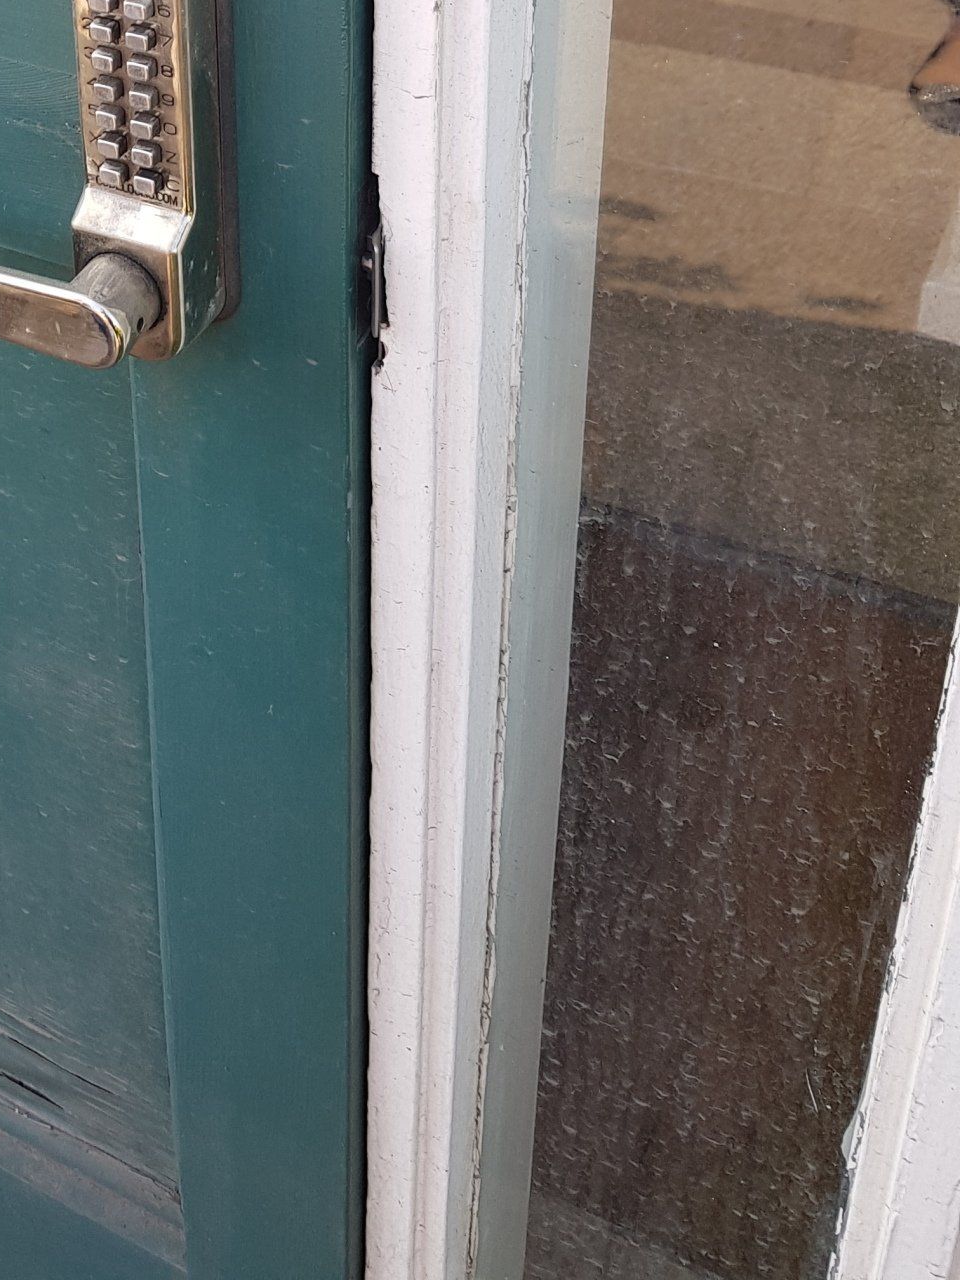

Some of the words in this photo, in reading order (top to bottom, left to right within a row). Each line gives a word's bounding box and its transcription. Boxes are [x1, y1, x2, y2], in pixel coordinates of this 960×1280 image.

[157, 4, 171, 18] 6
[159, 33, 173, 48] 7
[161, 64, 173, 78] 8
[162, 93, 175, 106] 9
[166, 150, 178, 165] Z
[166, 179, 180, 192] C
